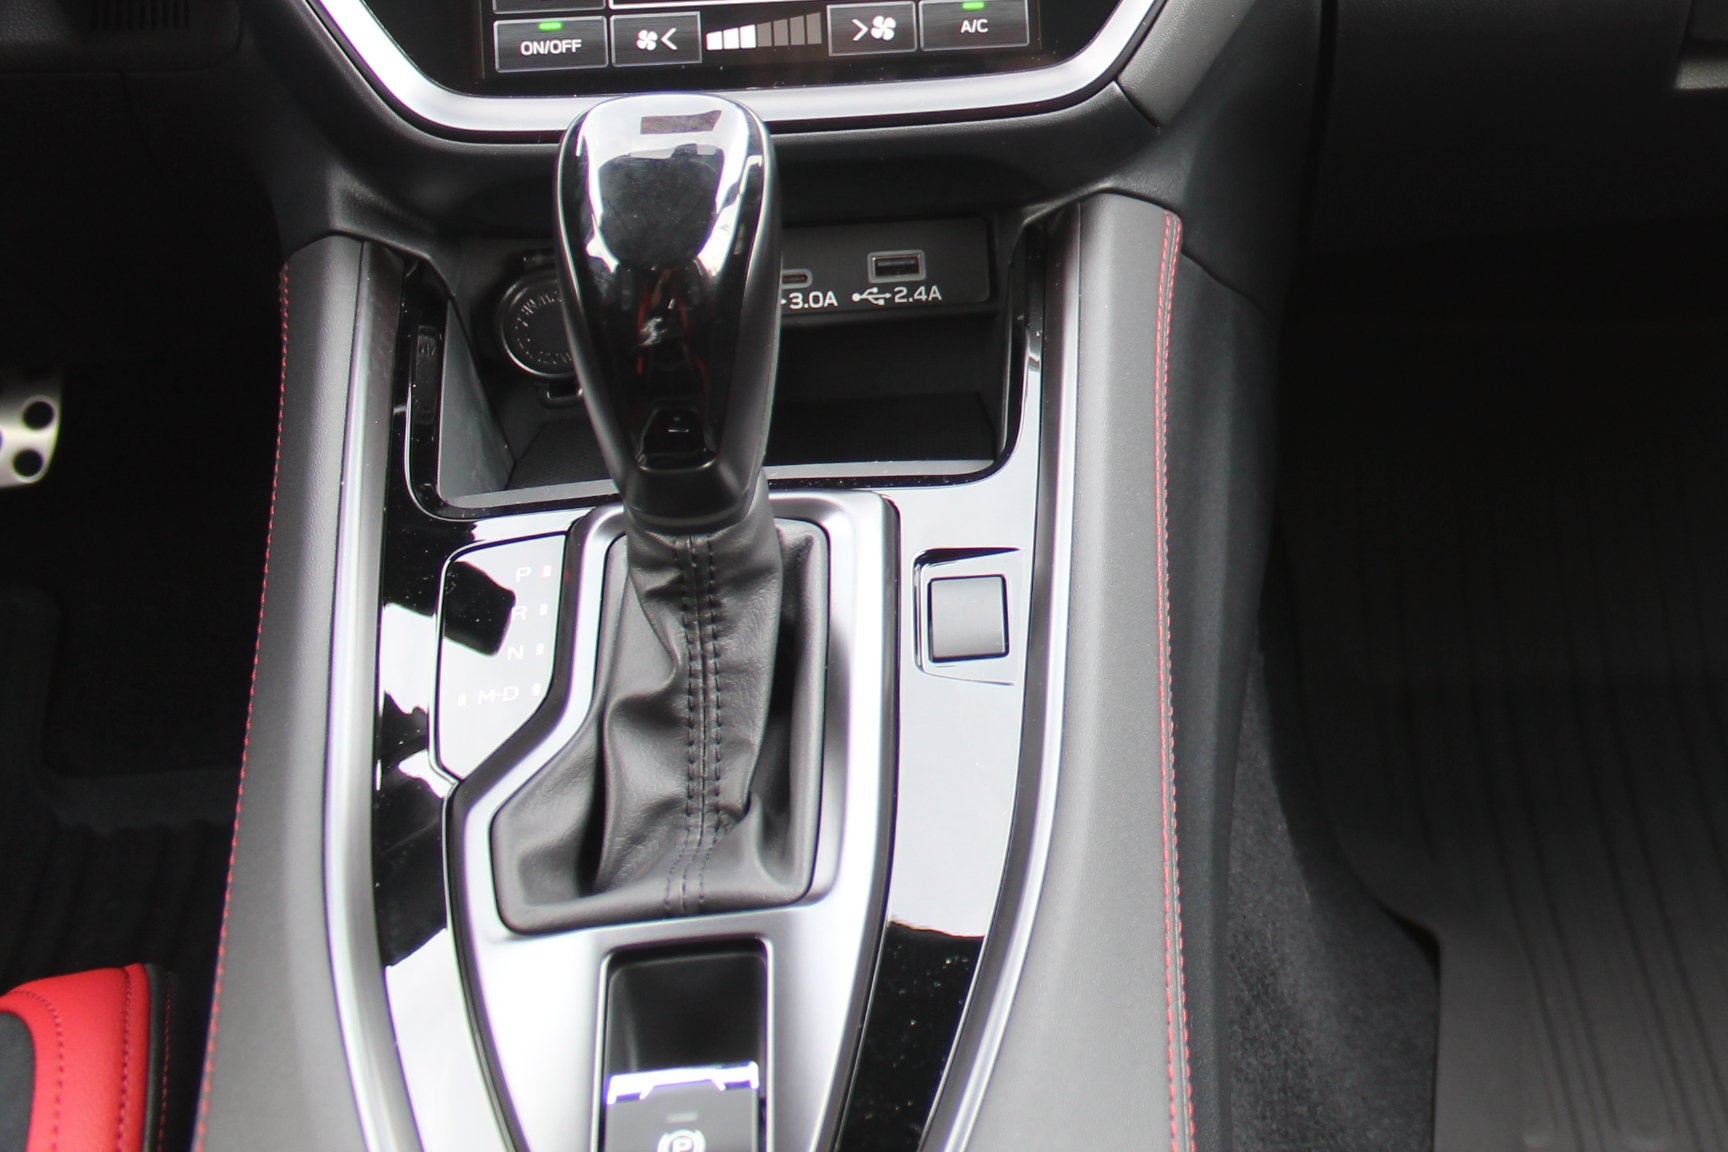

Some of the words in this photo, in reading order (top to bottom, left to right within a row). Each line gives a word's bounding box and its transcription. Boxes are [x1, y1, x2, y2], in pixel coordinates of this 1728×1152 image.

[961, 19, 988, 33] A/C
[521, 39, 581, 55] ON/OFF
[789, 291, 837, 309] 3.0A
[894, 286, 941, 302] 2.4A
[516, 567, 532, 582] P
[507, 645, 524, 661] N
